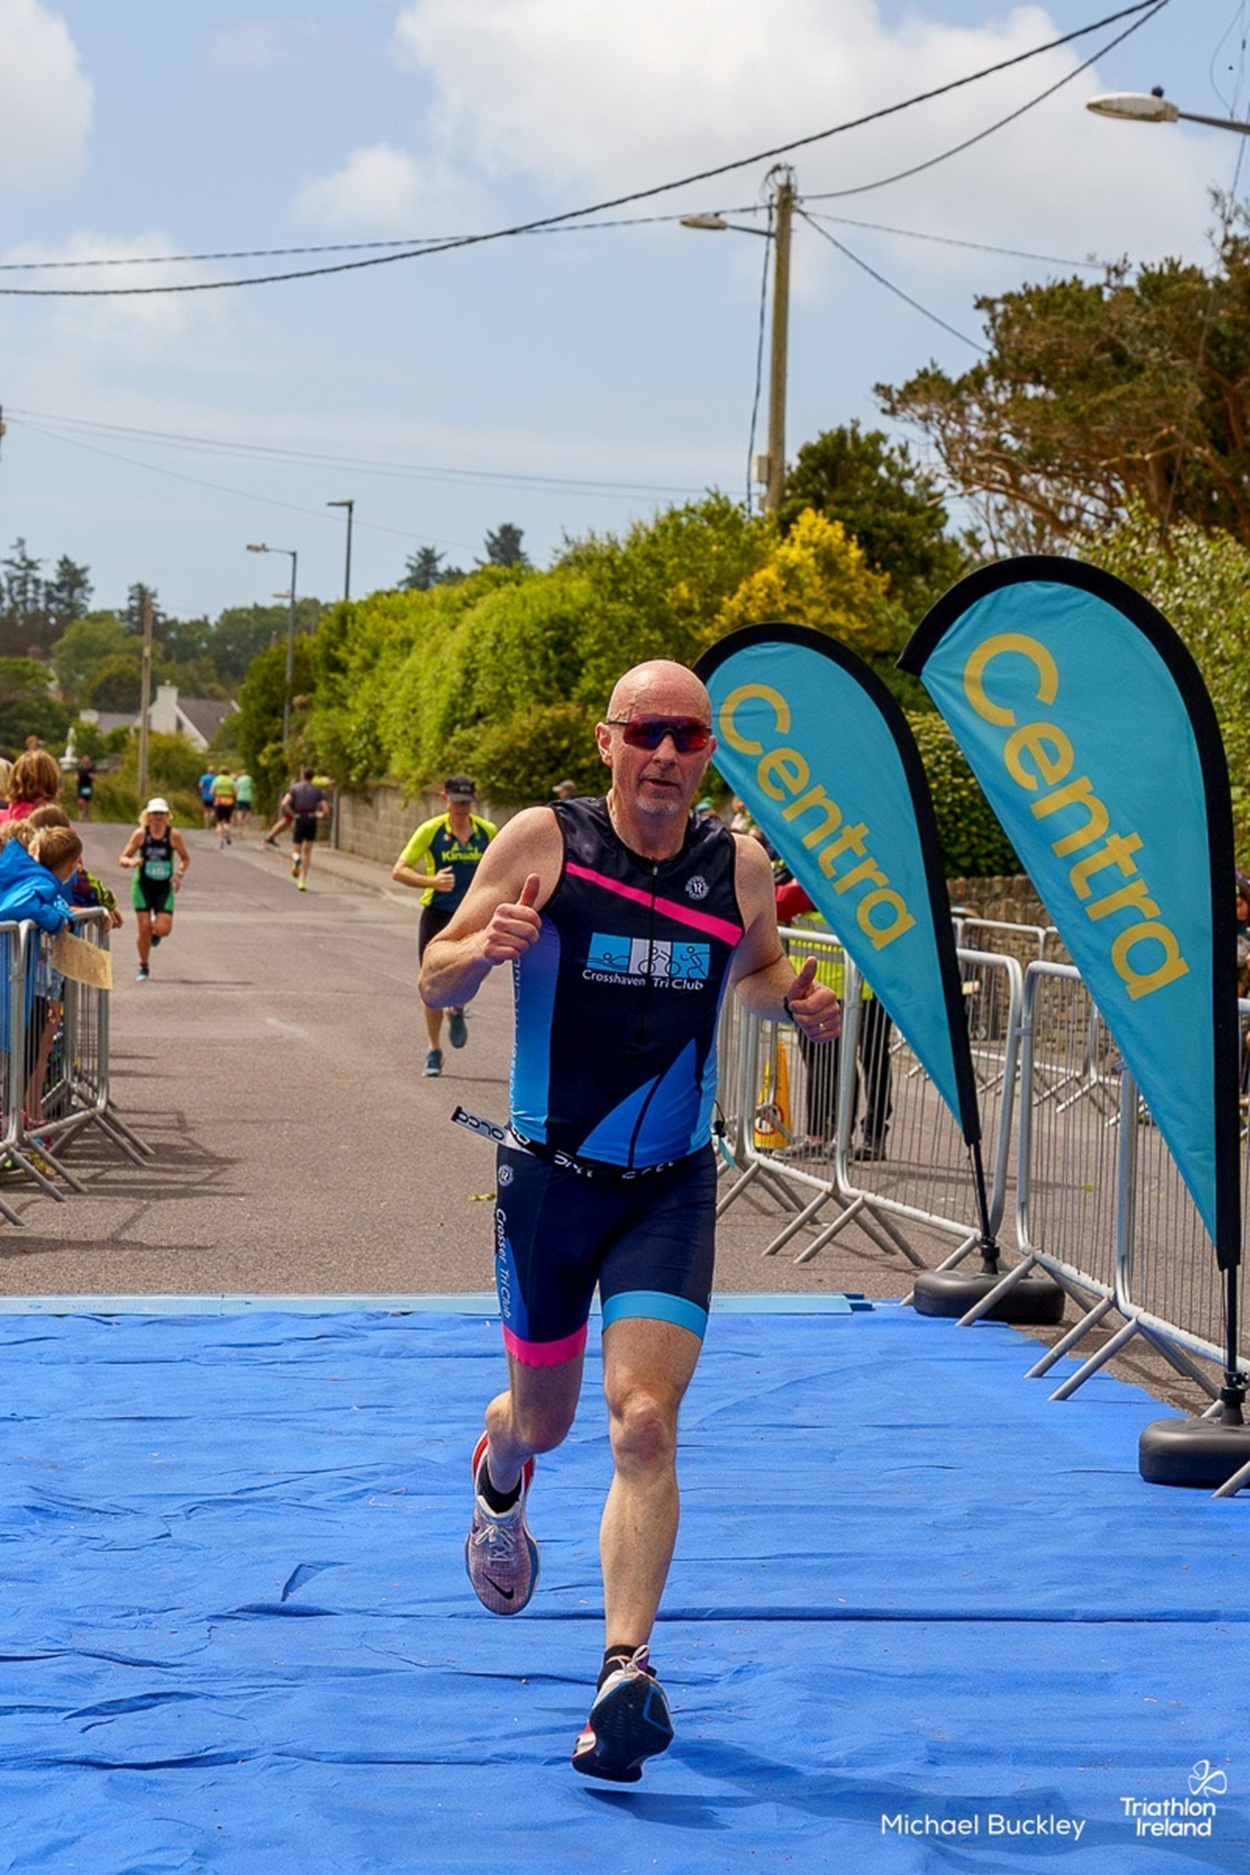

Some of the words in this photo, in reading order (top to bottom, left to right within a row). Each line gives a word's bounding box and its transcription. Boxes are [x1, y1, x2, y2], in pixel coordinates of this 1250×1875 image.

[719, 683, 917, 951] Centra
[963, 633, 1190, 1000] Centra
[582, 969, 646, 986] Crosshaven
[653, 978, 669, 988] Tri
[671, 979, 704, 990] Club
[501, 1286, 512, 1318] Club
